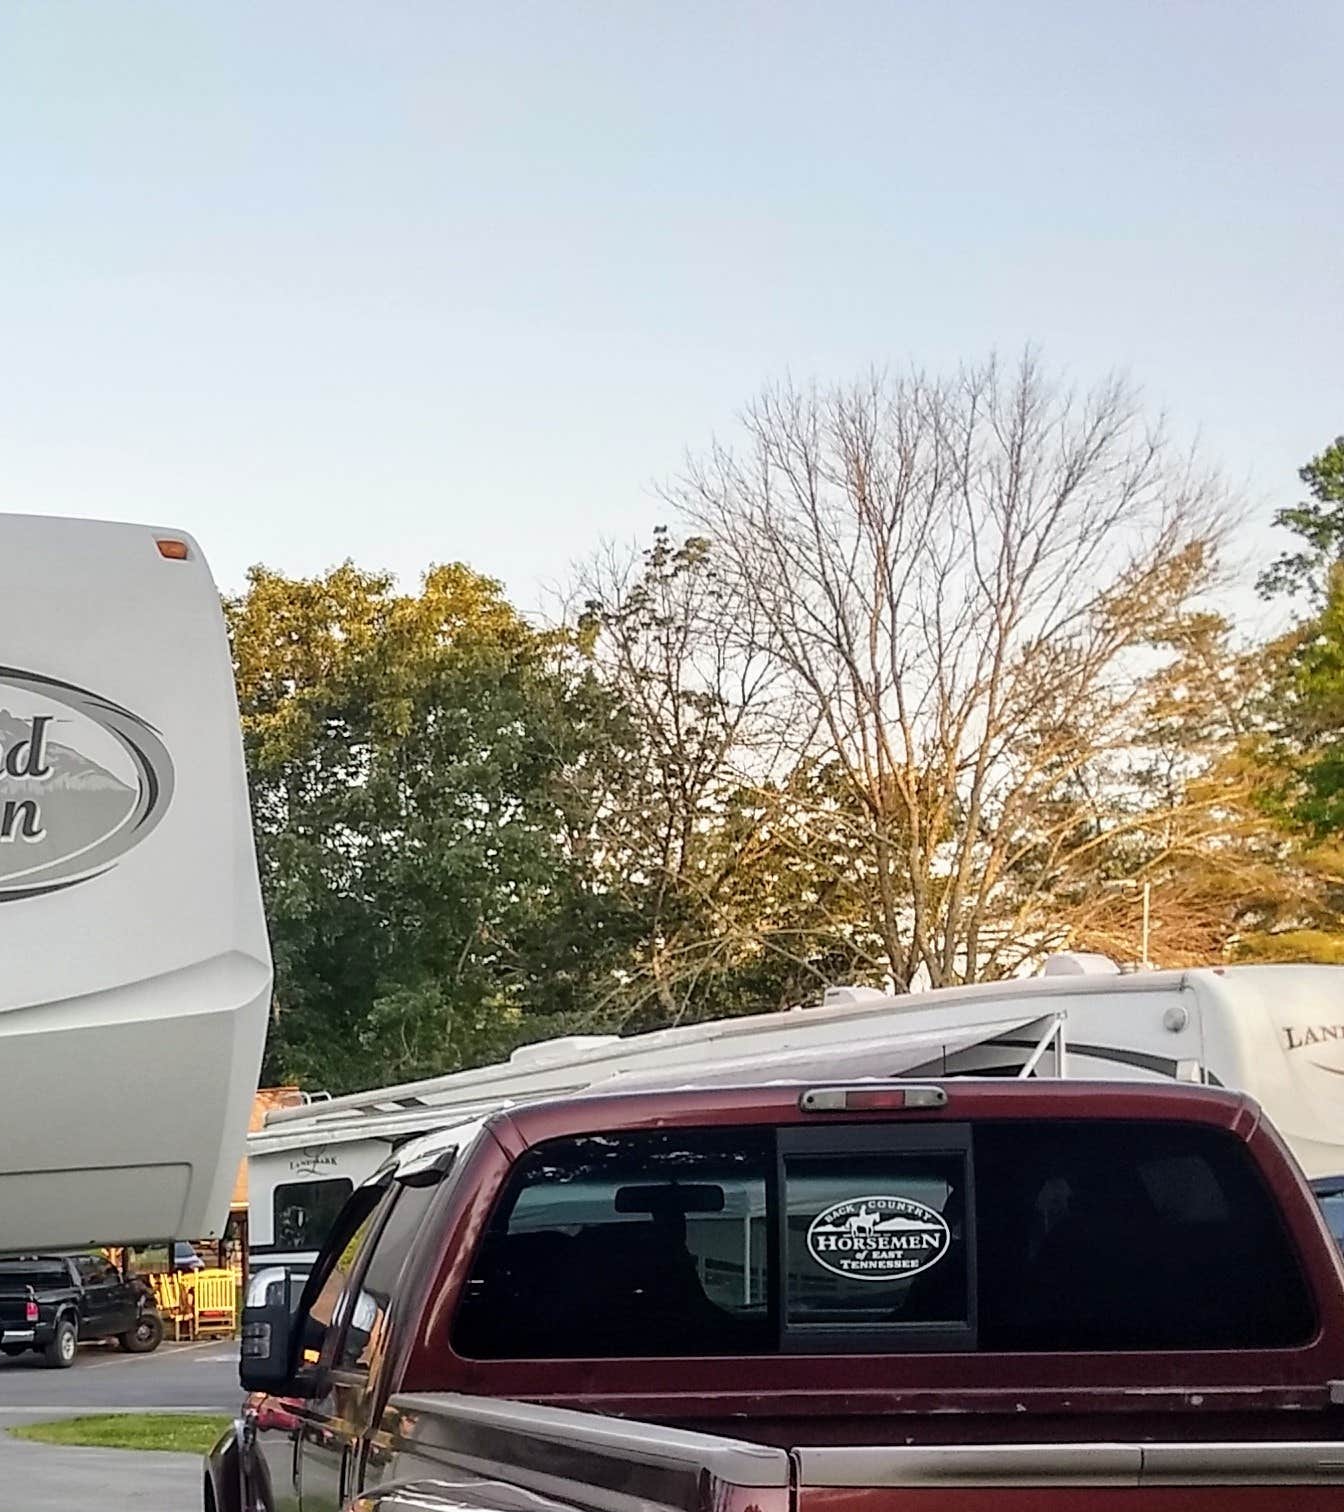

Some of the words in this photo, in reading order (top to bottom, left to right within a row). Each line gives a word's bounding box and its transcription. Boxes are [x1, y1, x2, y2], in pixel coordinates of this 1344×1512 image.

[1282, 1024, 1344, 1050] LAN
[823, 1204, 855, 1222] BACK
[868, 1200, 933, 1221] COUNTRY
[817, 1232, 940, 1250] HORSEMEN
[855, 1250, 868, 1259] of
[872, 1251, 903, 1259] EAST
[840, 1259, 919, 1269] TENNESSEE
